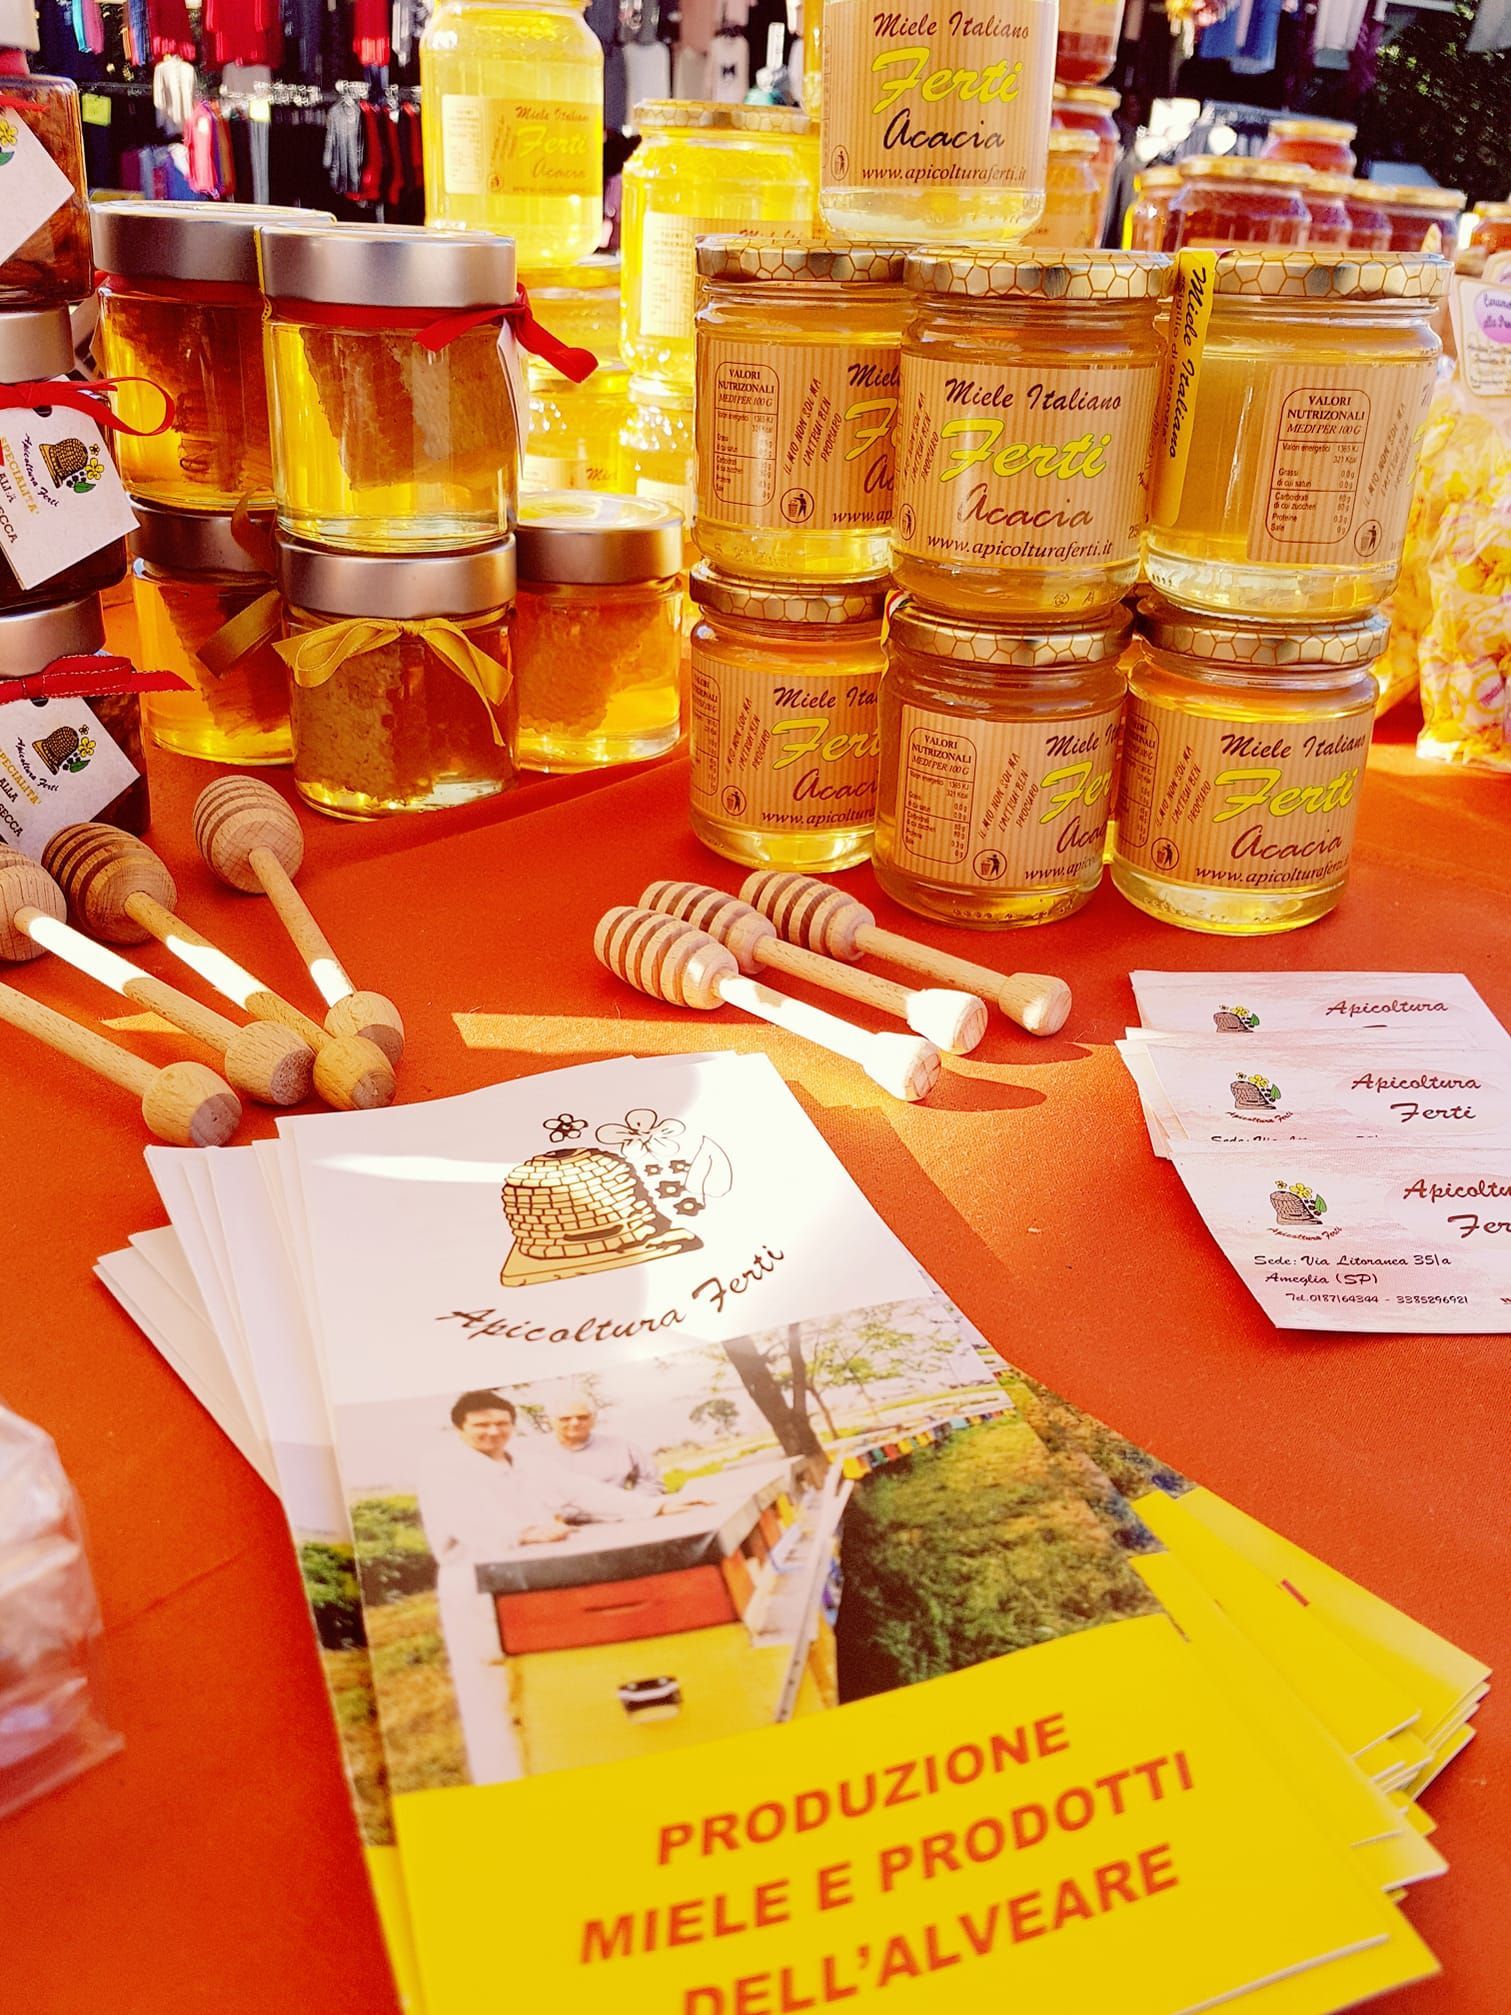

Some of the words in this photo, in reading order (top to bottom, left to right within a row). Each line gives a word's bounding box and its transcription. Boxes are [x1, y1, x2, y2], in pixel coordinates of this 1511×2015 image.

[872, 12, 937, 38] Miele
[948, 11, 1029, 39] Italiano
[871, 46, 1024, 115] Ferti
[883, 107, 1006, 149] Acacia
[862, 164, 1026, 185] www.apicolturaferti.it
[1183, 266, 1206, 347] Miele
[718, 380, 775, 394] NUTRIZONALI
[729, 368, 761, 380] VALORI
[944, 378, 1014, 408] Miele
[1026, 383, 1121, 411] Italiano
[1308, 396, 1351, 406] VALORI
[795, 418, 808, 444] NON
[802, 398, 815, 419] SOL
[811, 377, 822, 396] MA
[817, 396, 832, 420] BEN
[1169, 358, 1196, 459] Italiano
[1287, 409, 1365, 421] NUTRIZONALI
[820, 411, 843, 463] PROCURO
[1287, 423, 1316, 433] MEDI
[1316, 424, 1337, 434] PER
[1353, 426, 1361, 435] G
[939, 417, 1113, 483] Ferti
[20, 432, 39, 489] Apicoltura
[37, 486, 60, 507] Ferti
[957, 483, 1094, 529] Acacia
[927, 534, 1113, 562] www.apicolturaferti.it
[773, 686, 836, 709] Miele
[911, 743, 972, 764] NUTRIZONALI
[924, 735, 957, 750] VALORI
[1045, 732, 1099, 757] Miele
[1183, 745, 1193, 763] MA
[1220, 734, 1292, 758] Miele
[1302, 733, 1366, 758] Italiano
[15, 736, 37, 782] Apicoltura
[37, 777, 60, 792] Ferti
[1187, 763, 1201, 784] BEN
[0, 776, 18, 803] ALLA
[991, 786, 1005, 810] NON
[1008, 752, 1021, 771] MA
[1017, 770, 1030, 791] BEN
[1015, 783, 1039, 829] PROCURO
[1187, 780, 1212, 824] PROCURO
[1211, 767, 1359, 824] Ferti
[1230, 824, 1342, 860] Acacia
[1325, 999, 1449, 1018] Apicoltura
[1351, 1072, 1482, 1091] Apicoltura
[1390, 1102, 1477, 1123] Ferti
[1266, 1226, 1323, 1242] Apicoltura
[1322, 1226, 1344, 1241] Ferti
[1254, 1255, 1298, 1267] Sede:
[1301, 1255, 1330, 1267] Via
[1336, 1254, 1409, 1267] Litoranea
[1265, 1272, 1330, 1286] Ameglia
[1335, 1273, 1379, 1286] (SP)
[435, 1307, 688, 1344] Apicoltura
[690, 1244, 785, 1313] Ferti
[1396, 1294, 1469, 1305] 3385296921
[656, 1711, 1071, 1867] PRODUZIONE
[579, 1878, 792, 1966] MIELE
[816, 1860, 855, 1912] E
[878, 1749, 1195, 1893] PRODOTTI
